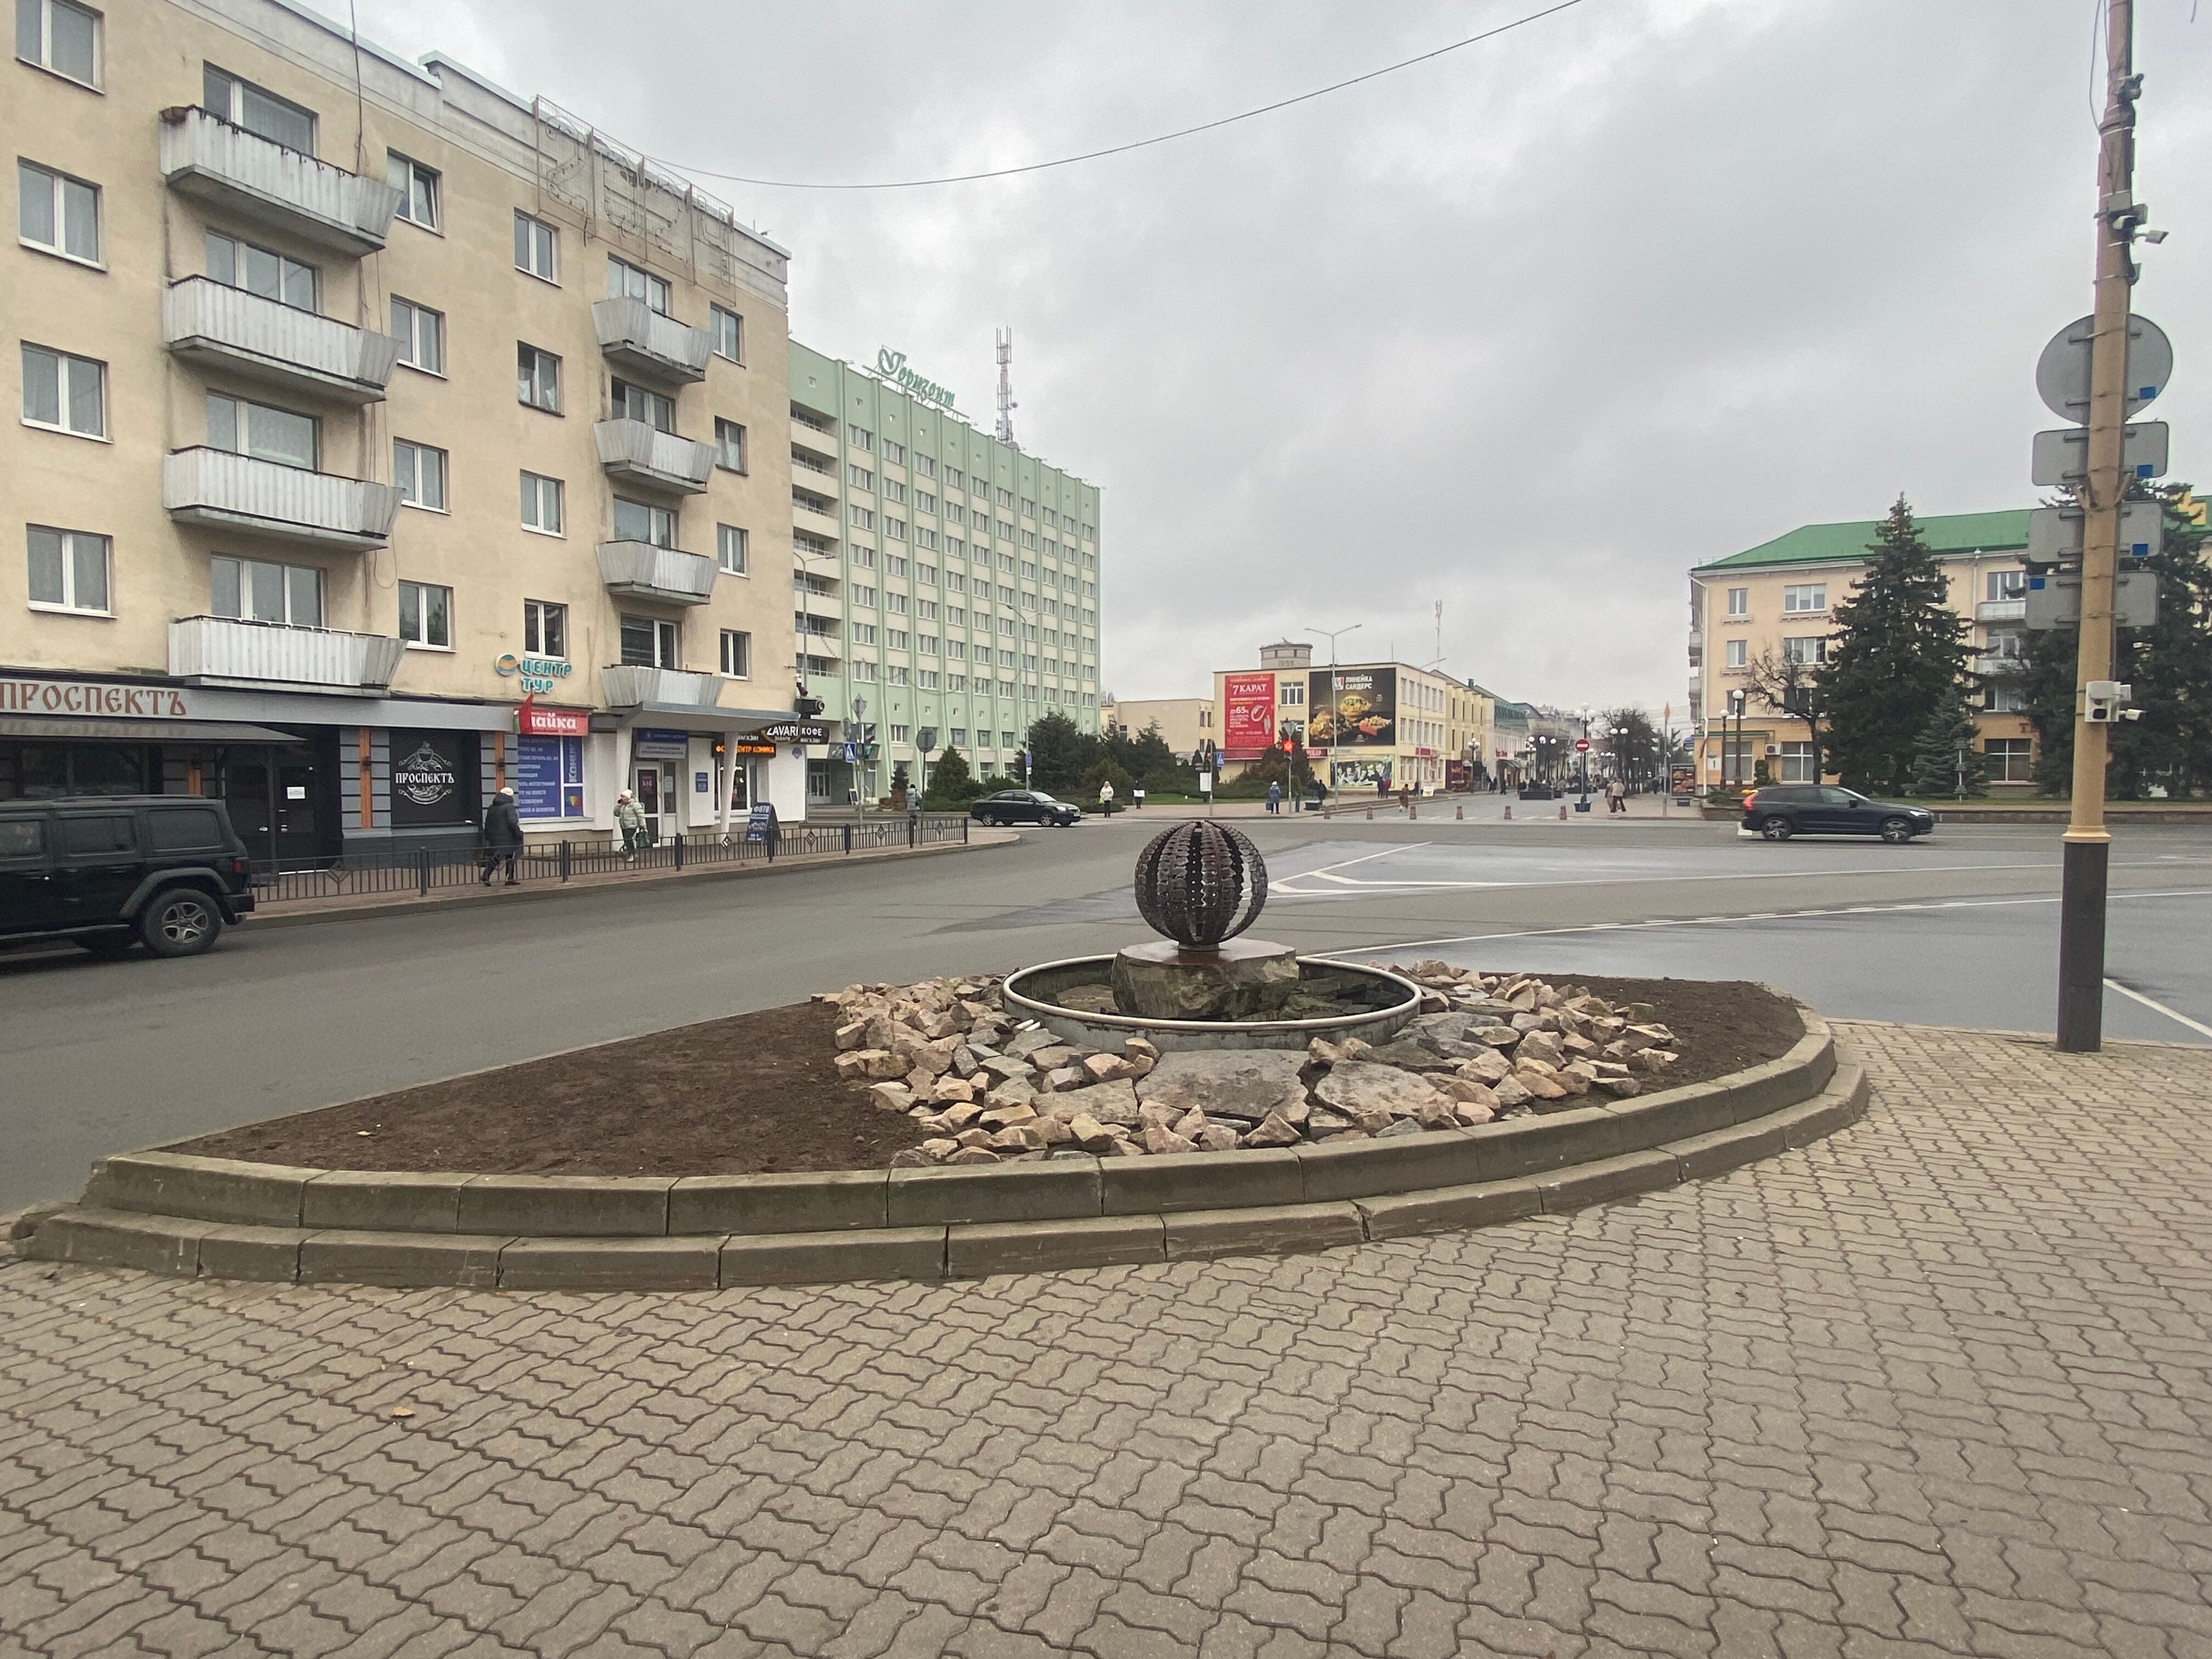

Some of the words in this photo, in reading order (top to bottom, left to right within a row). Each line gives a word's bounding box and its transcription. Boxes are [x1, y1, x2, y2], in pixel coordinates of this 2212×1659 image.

[522, 659, 572, 677] ЦЕНТР
[522, 678, 553, 693] ТУР
[0, 682, 187, 715] ПРОСПЕКТЪ
[531, 712, 577, 729] айка
[802, 727, 822, 736] КОФЕ
[395, 772, 454, 783] ПРОСПЕКТЪ
